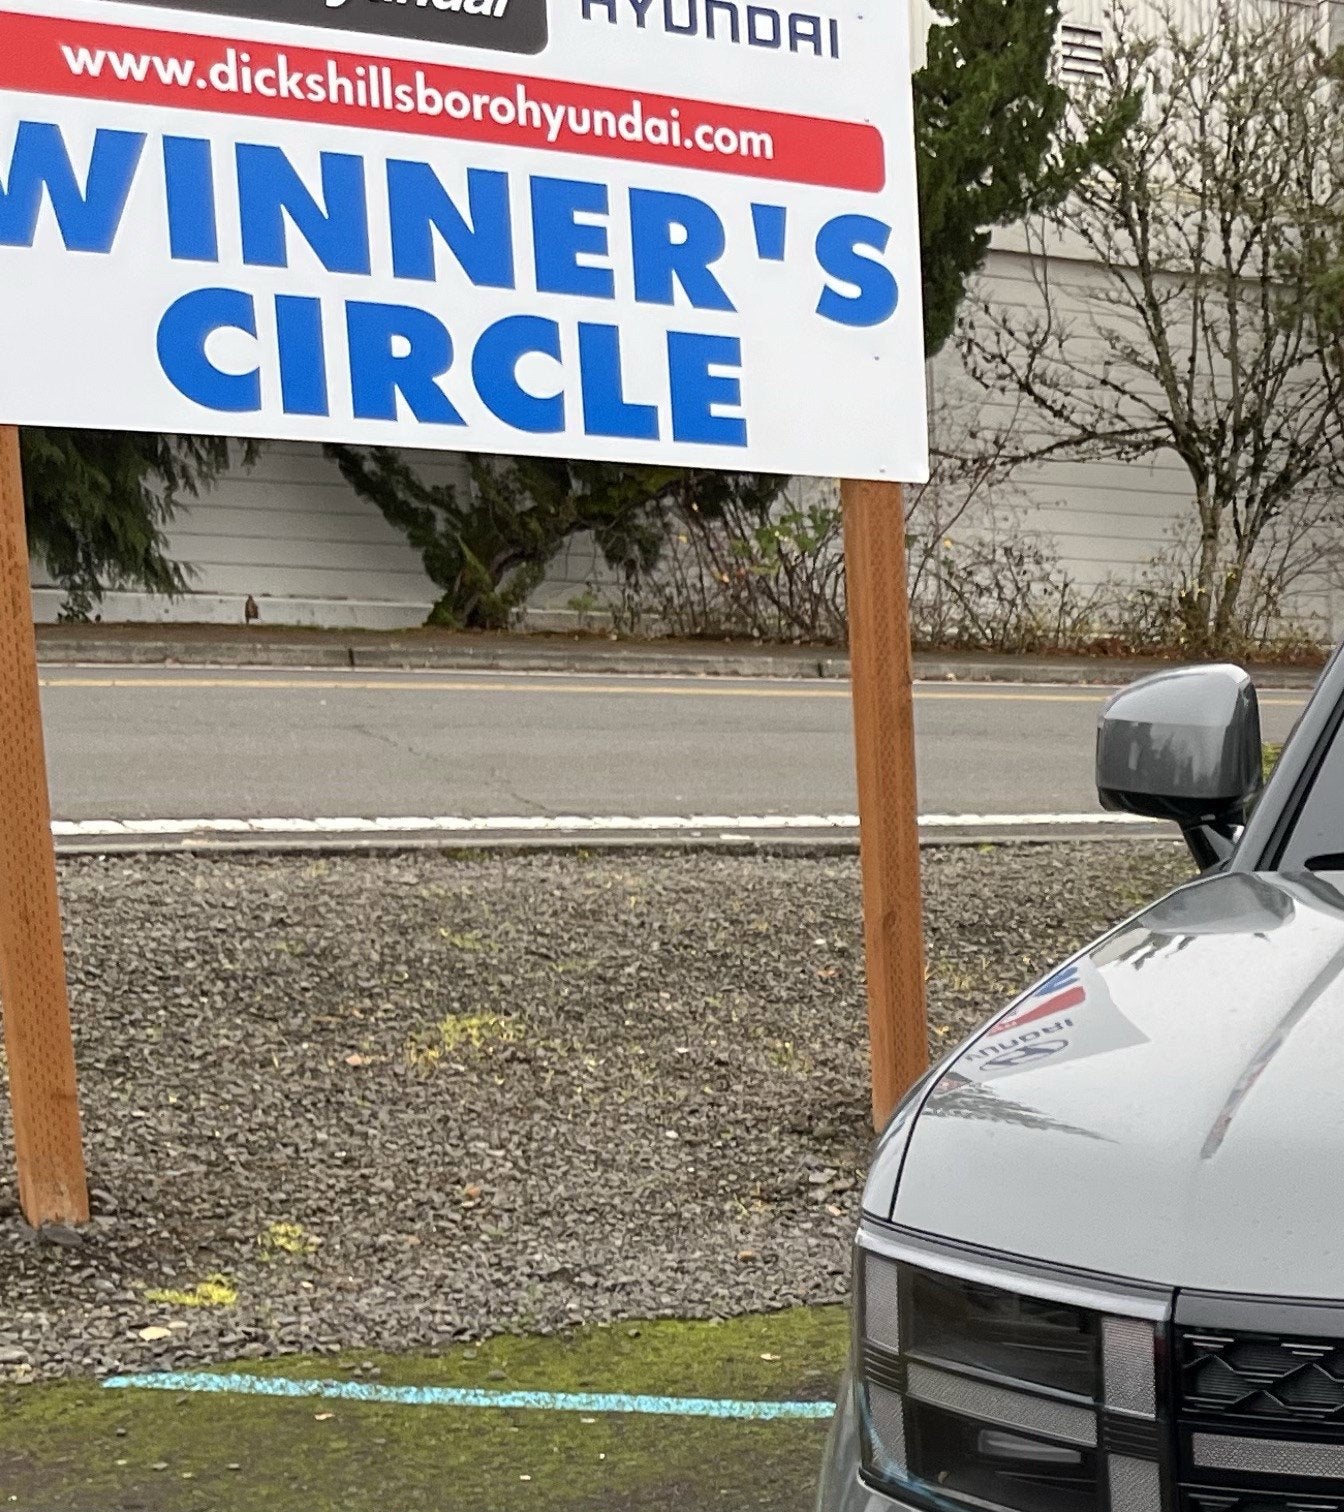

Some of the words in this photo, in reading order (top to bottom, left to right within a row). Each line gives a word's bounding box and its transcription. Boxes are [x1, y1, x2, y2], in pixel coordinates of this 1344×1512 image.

[61, 41, 774, 160] www.dickshillsborohyundai.com
[0, 119, 898, 327] WINNER'S
[156, 287, 748, 446] CIRCLE
